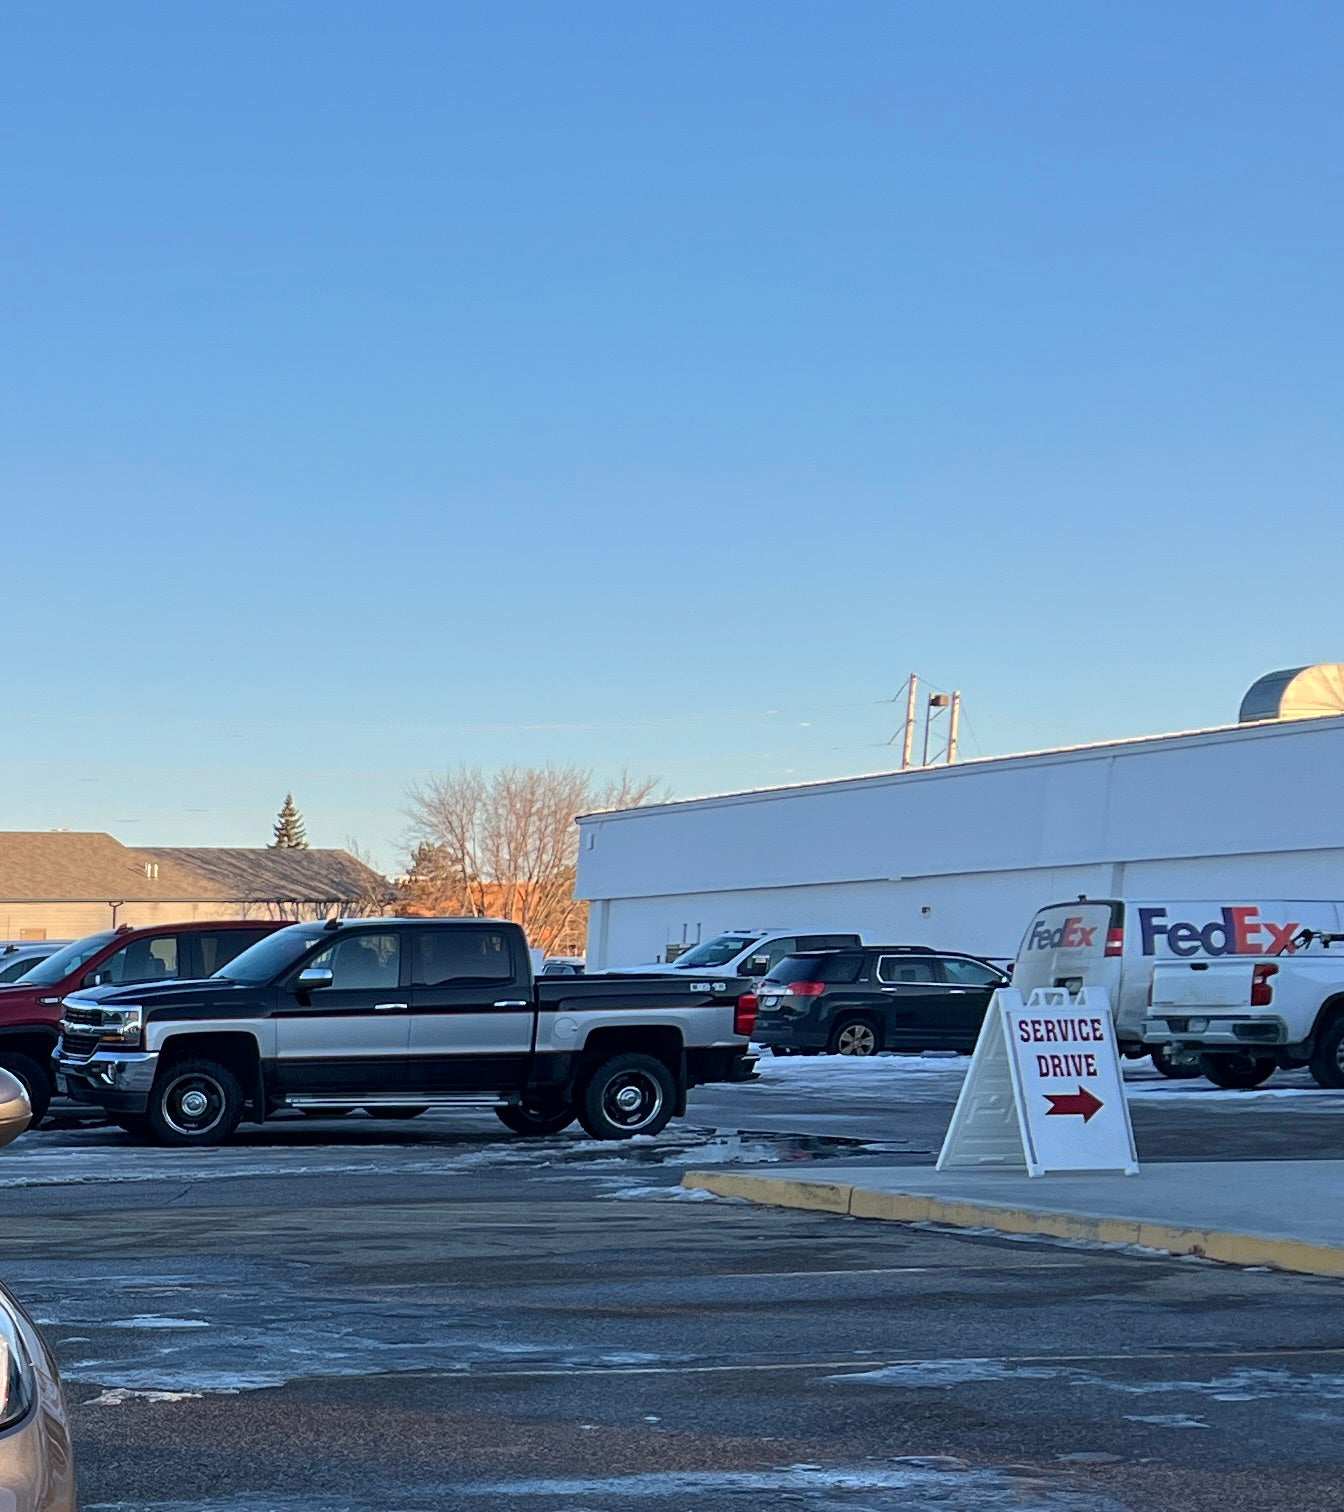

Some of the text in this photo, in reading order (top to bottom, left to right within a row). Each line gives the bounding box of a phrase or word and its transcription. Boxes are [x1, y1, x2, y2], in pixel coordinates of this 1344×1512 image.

[1027, 916, 1098, 951] FedEx
[1138, 907, 1300, 956] FedEx
[1018, 1018, 1104, 1043] SERVICE
[1036, 1053, 1098, 1078] DRIVE
